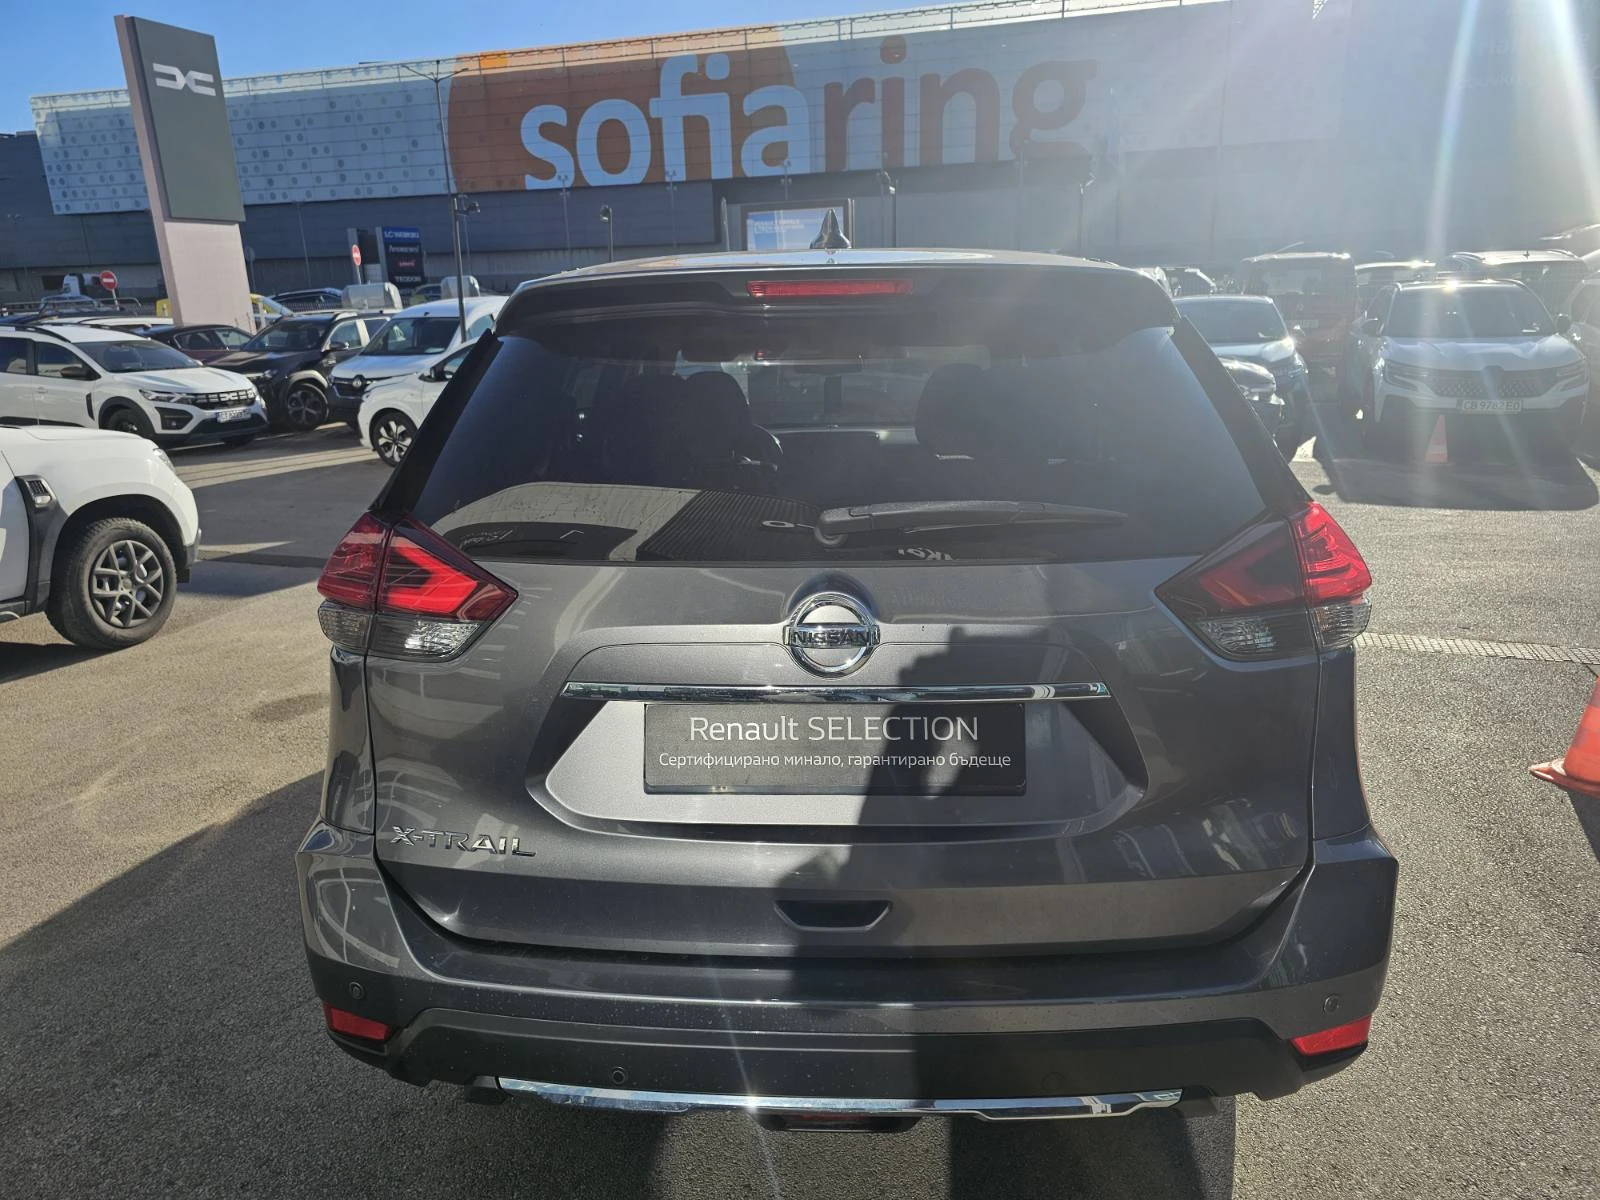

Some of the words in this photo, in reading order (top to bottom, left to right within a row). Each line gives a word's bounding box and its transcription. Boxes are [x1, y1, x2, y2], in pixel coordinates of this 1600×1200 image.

[520, 35, 1097, 189] sofiaring
[791, 629, 869, 644] NISSAN
[690, 715, 800, 741] Renault
[808, 716, 978, 741] SELECTION
[659, 752, 780, 769] Сертифицирано
[784, 755, 844, 768] минало,
[848, 755, 946, 768] гарантирано
[949, 752, 1011, 768] бъдеще
[390, 825, 536, 857] X-TRAIL
